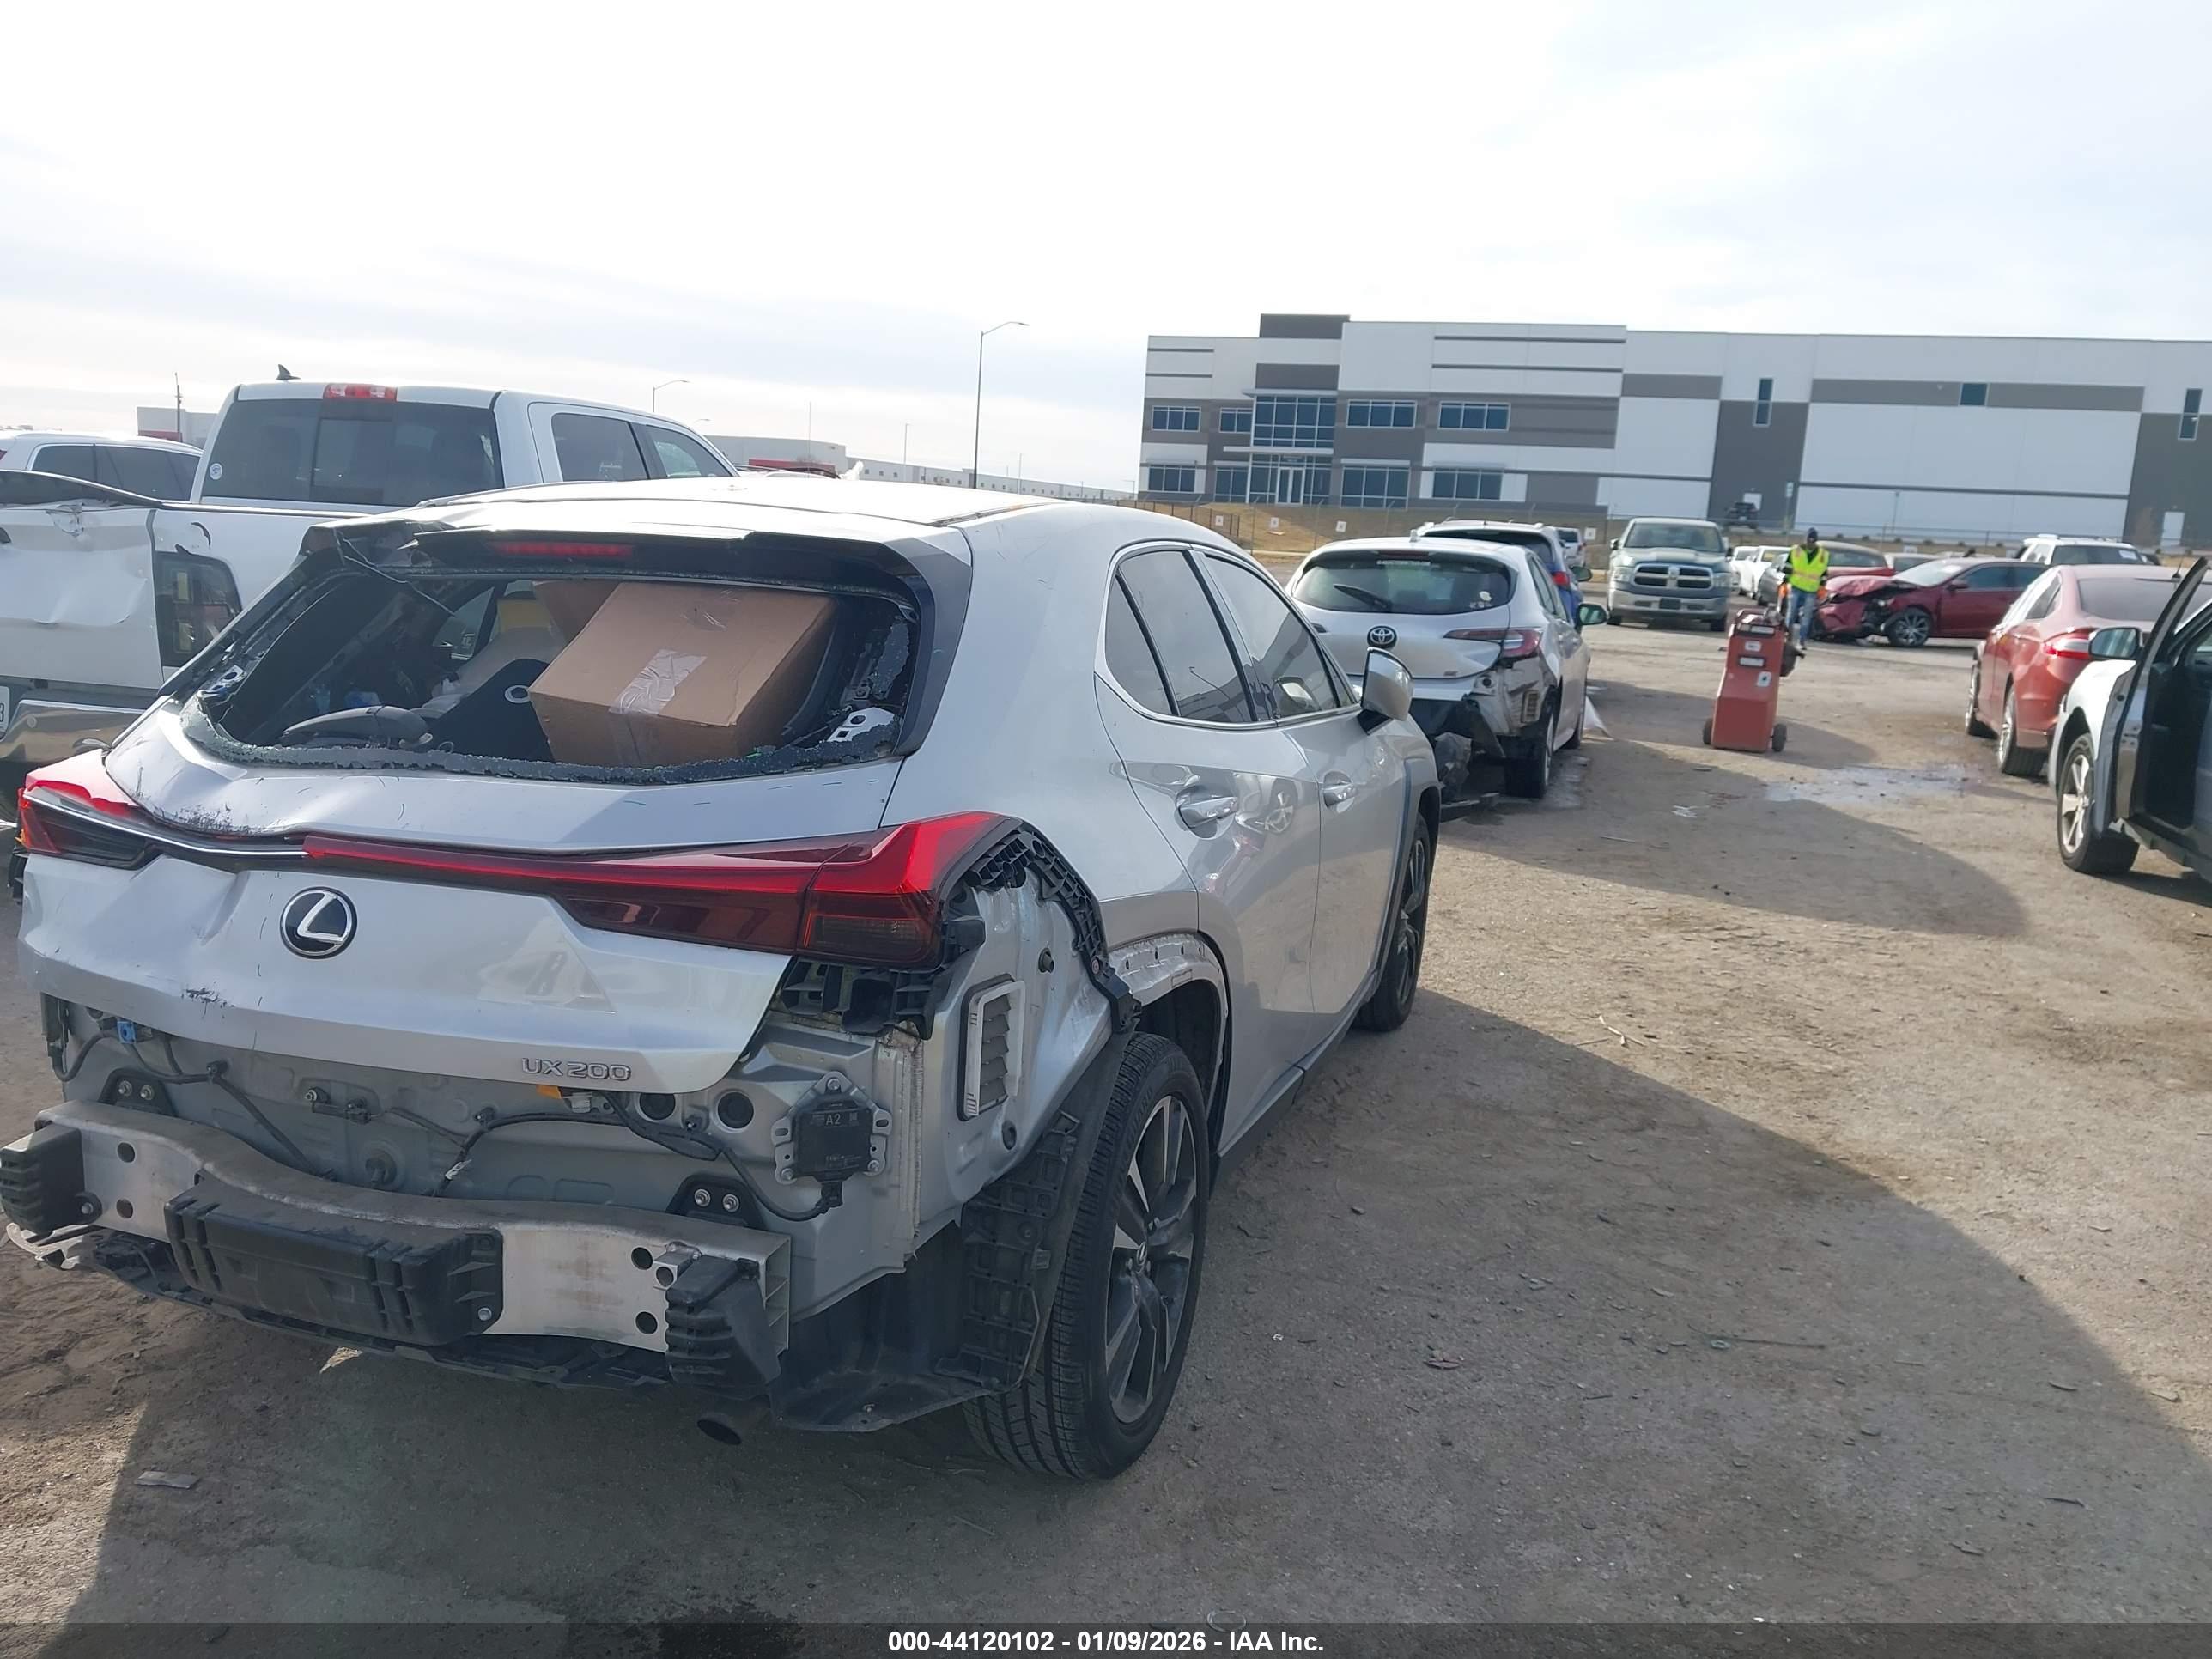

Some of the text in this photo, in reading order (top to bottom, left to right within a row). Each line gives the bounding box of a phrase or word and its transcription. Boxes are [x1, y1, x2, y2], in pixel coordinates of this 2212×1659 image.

[521, 1057, 632, 1082] UX 200
[825, 1113, 842, 1126] A2
